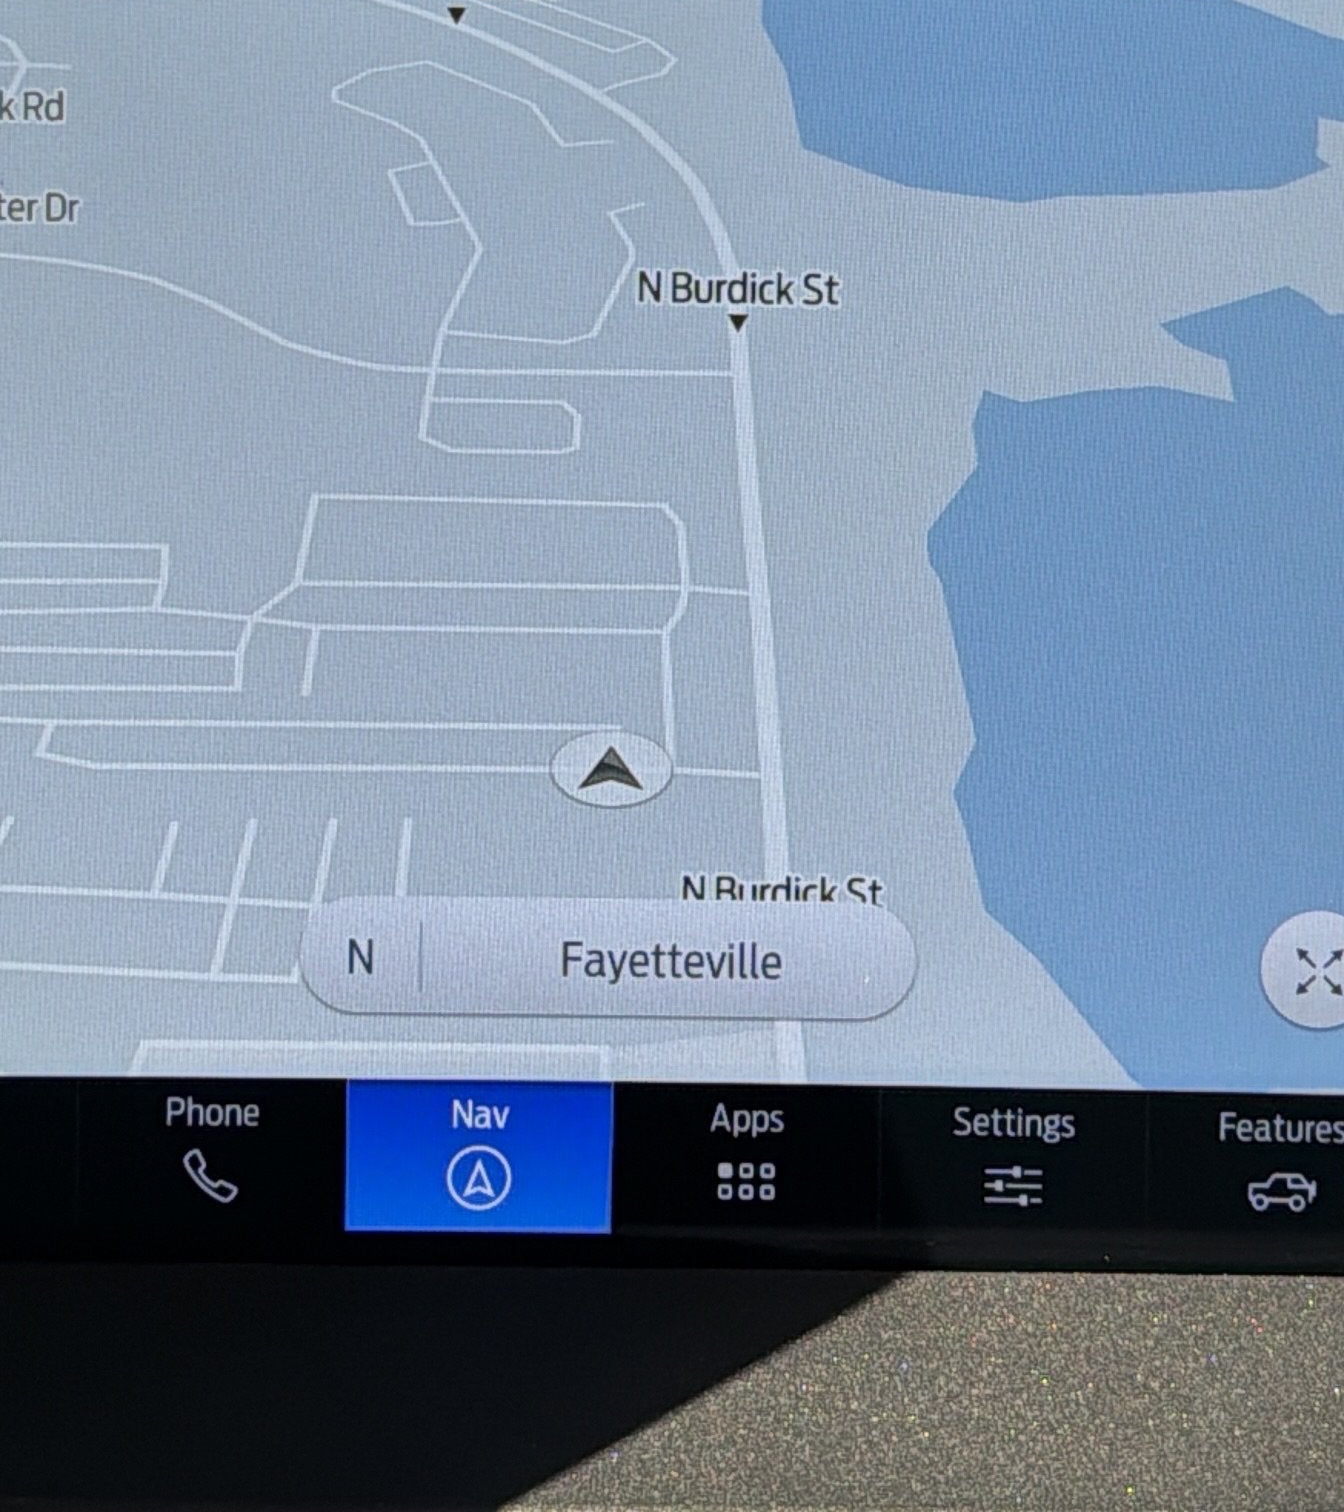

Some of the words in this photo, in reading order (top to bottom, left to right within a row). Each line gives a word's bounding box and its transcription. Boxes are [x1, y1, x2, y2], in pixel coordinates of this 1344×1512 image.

[24, 92, 63, 121] Rd
[46, 193, 78, 221] Dr
[640, 271, 660, 302] N
[672, 272, 792, 304] Burdick
[803, 274, 838, 304] St
[683, 876, 704, 899] N
[848, 878, 882, 905] St
[349, 939, 372, 974] N
[563, 942, 781, 984] Fayetteville
[167, 1097, 259, 1126] Phone
[453, 1100, 509, 1128] Nav
[711, 1103, 784, 1137] Apps
[954, 1107, 1075, 1143] Settings
